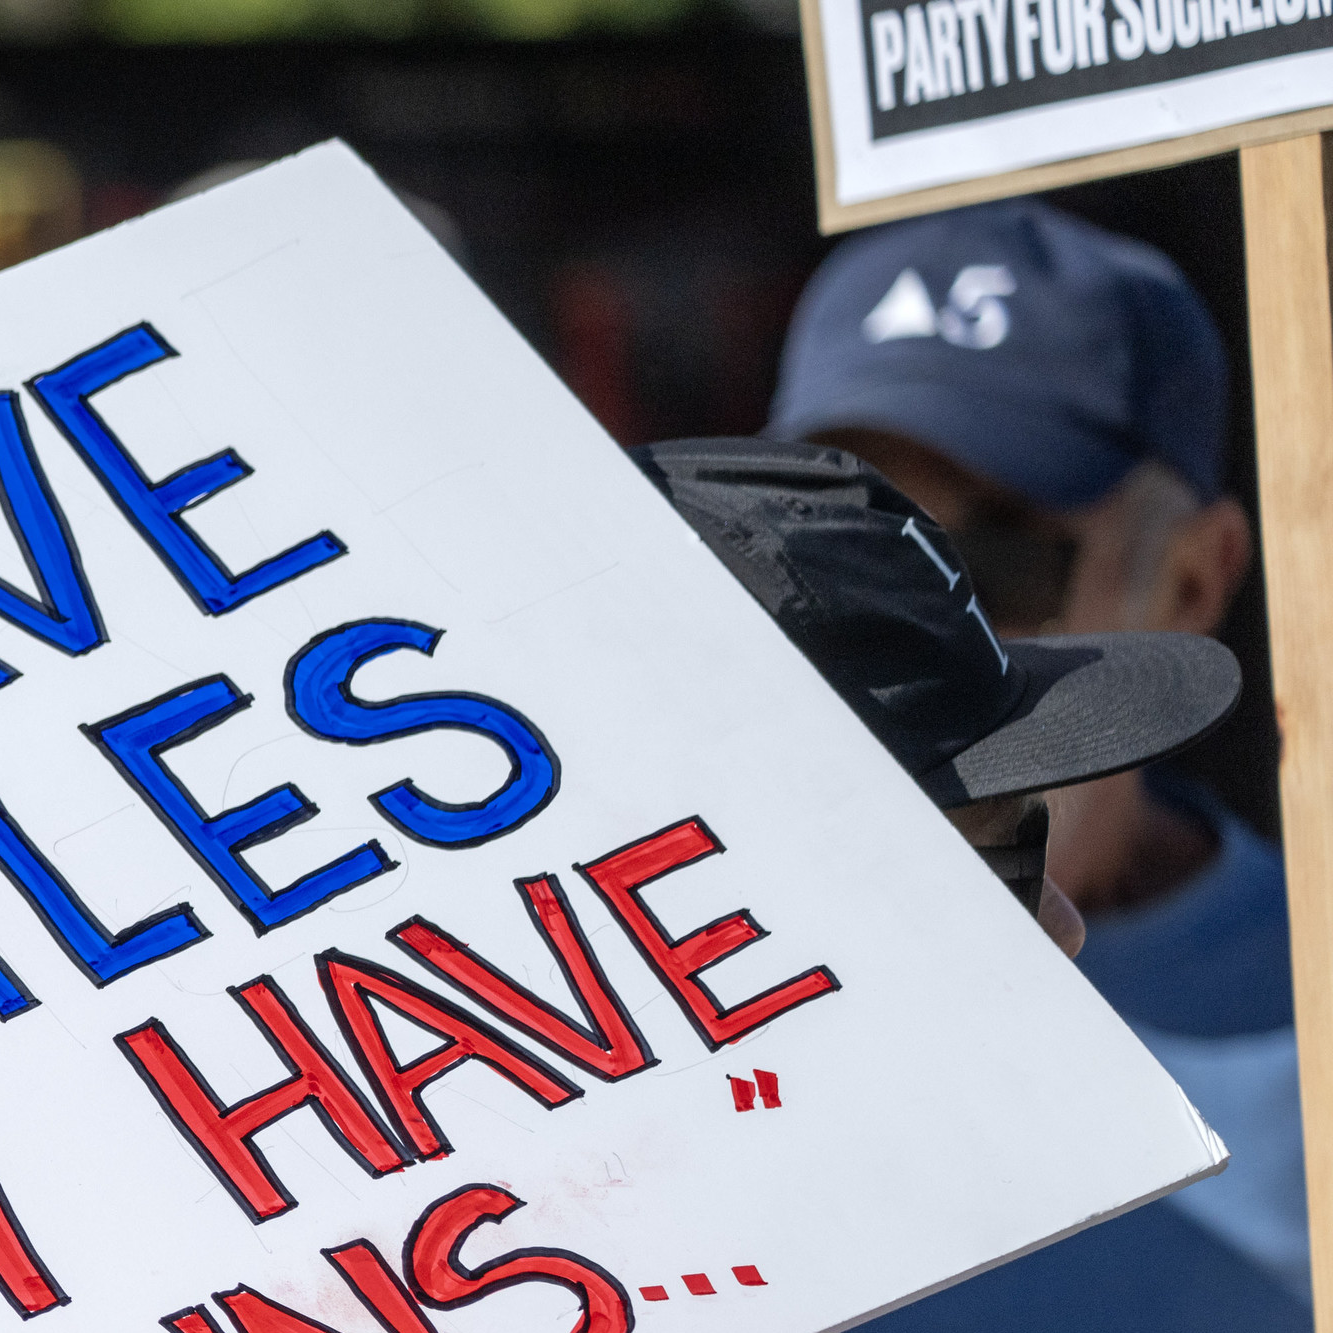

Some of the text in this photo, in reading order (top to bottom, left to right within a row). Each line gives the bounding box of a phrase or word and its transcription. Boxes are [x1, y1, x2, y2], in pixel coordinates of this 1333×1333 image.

[872, 0, 1010, 110] PARTY
[1014, 0, 1110, 82] FOR
[113, 815, 842, 1225] HAVE
